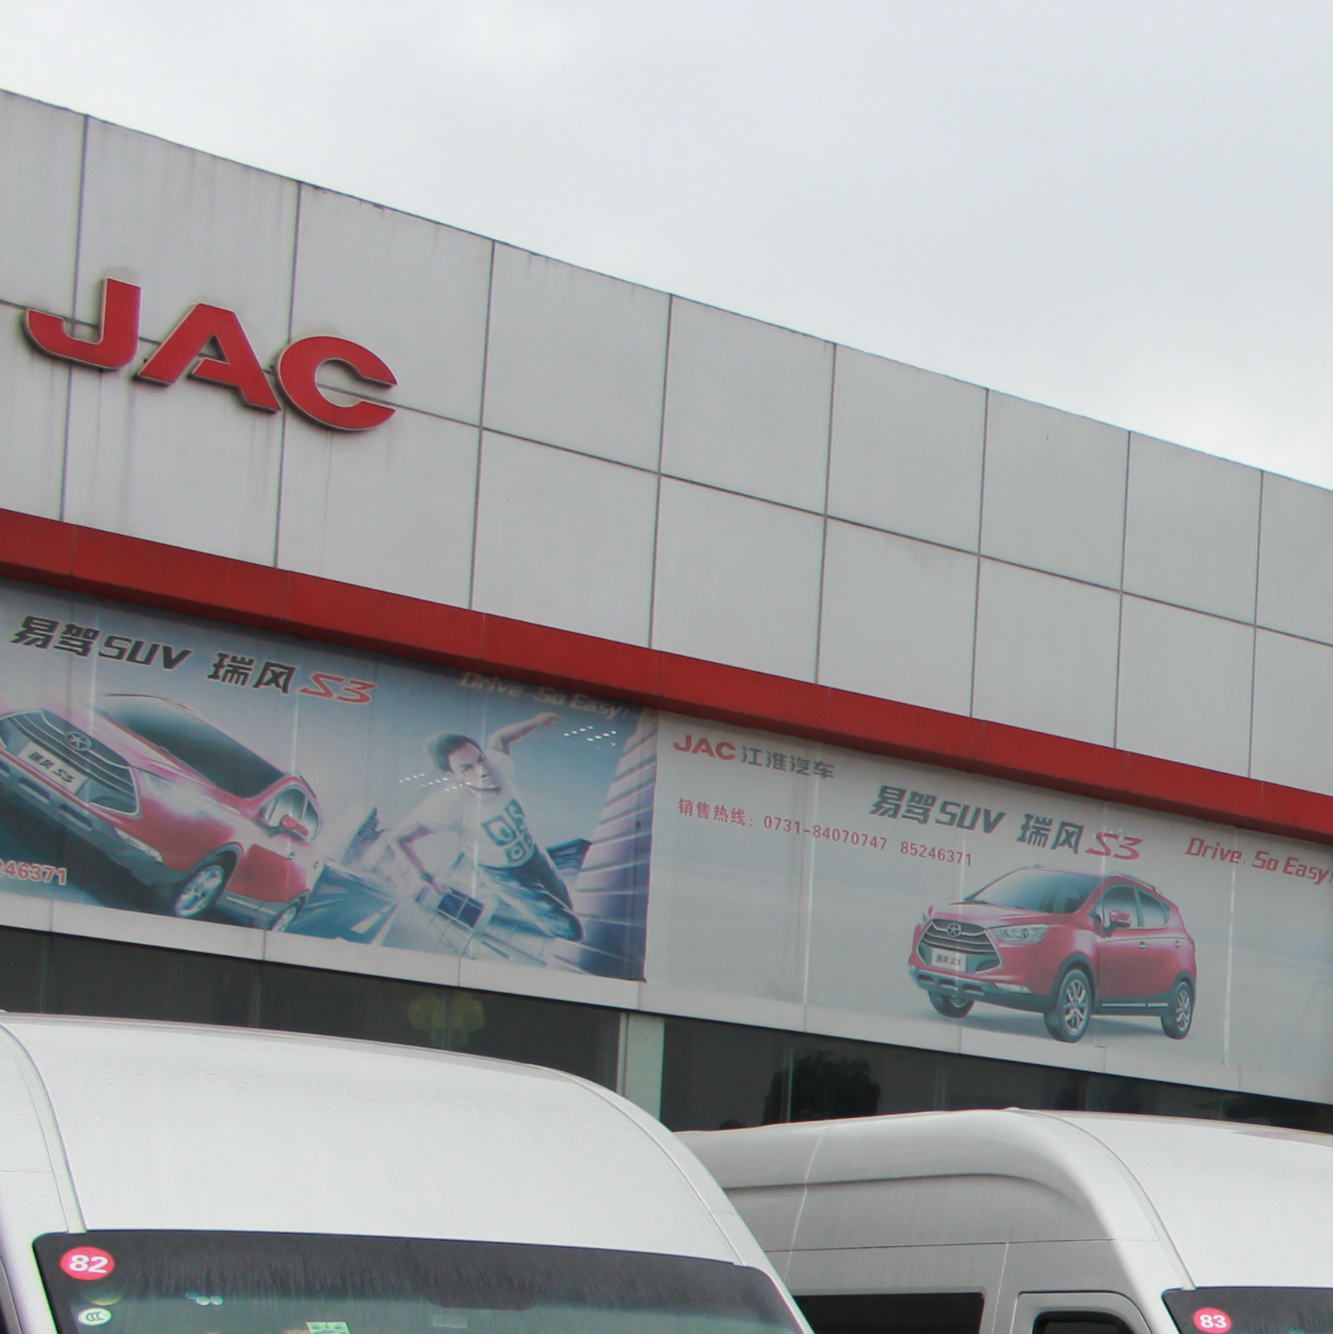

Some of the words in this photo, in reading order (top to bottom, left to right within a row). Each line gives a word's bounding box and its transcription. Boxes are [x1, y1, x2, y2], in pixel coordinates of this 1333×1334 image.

[24, 277, 398, 431] JAC
[673, 735, 736, 760] JAC
[741, 745, 835, 779] 江淮汽车
[763, 815, 888, 850] 0731-84070747
[900, 841, 972, 866] 85246371
[1252, 850, 1279, 870] So
[69, 1254, 109, 1274] 82
[1199, 1314, 1228, 1329] 83
